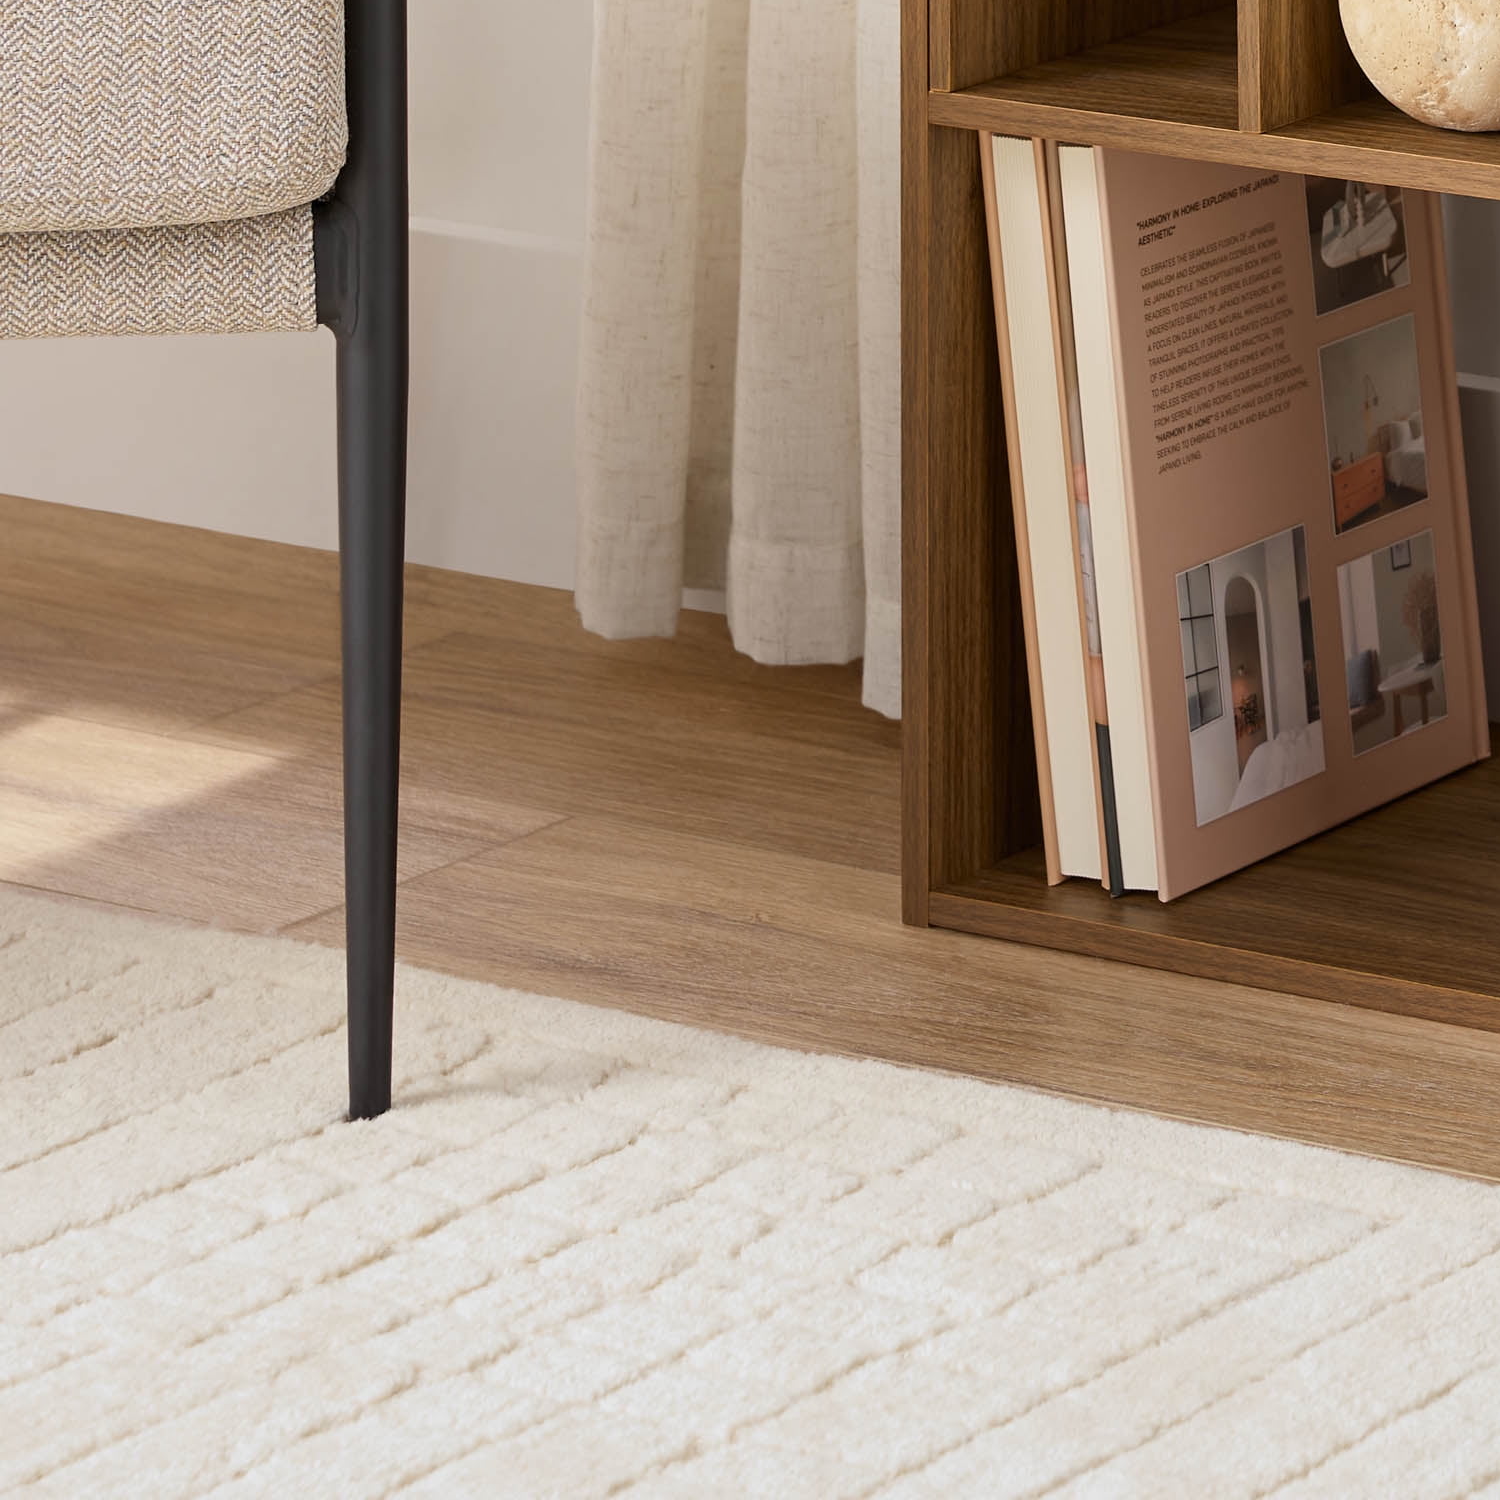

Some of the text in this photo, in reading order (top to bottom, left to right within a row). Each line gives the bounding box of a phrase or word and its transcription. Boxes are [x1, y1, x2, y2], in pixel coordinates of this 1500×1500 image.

[1136, 211, 1170, 231] "HARMONY
[1201, 187, 1238, 208] EXPLORING
[1238, 182, 1252, 195] THE
[1252, 172, 1280, 191] JAPANDI
[1137, 223, 1176, 246] AESTHETIC"
